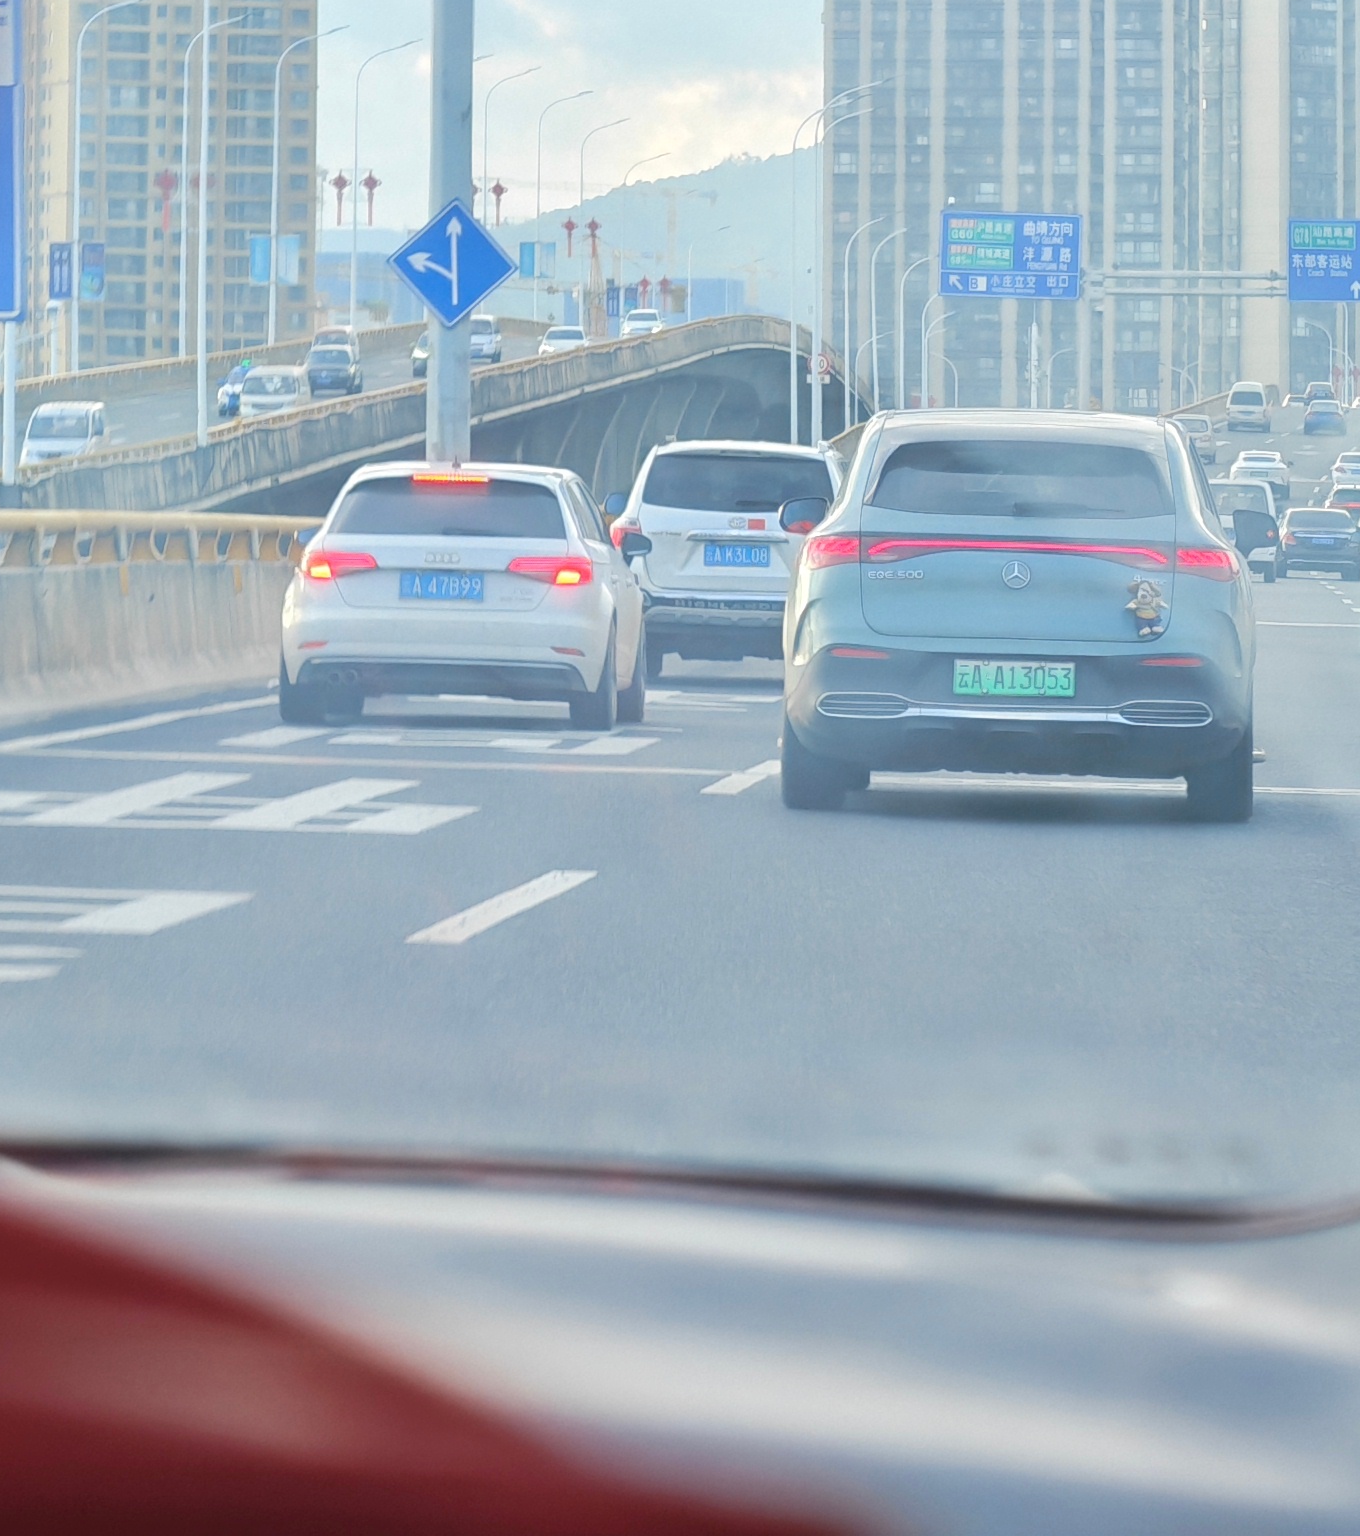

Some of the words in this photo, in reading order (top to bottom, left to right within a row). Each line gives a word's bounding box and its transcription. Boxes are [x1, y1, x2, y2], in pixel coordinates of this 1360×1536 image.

[1291, 253, 1353, 270] 东部客运站
[1047, 275, 1069, 288] 出口
[867, 570, 895, 579] EQE
[897, 570, 924, 579] 500
